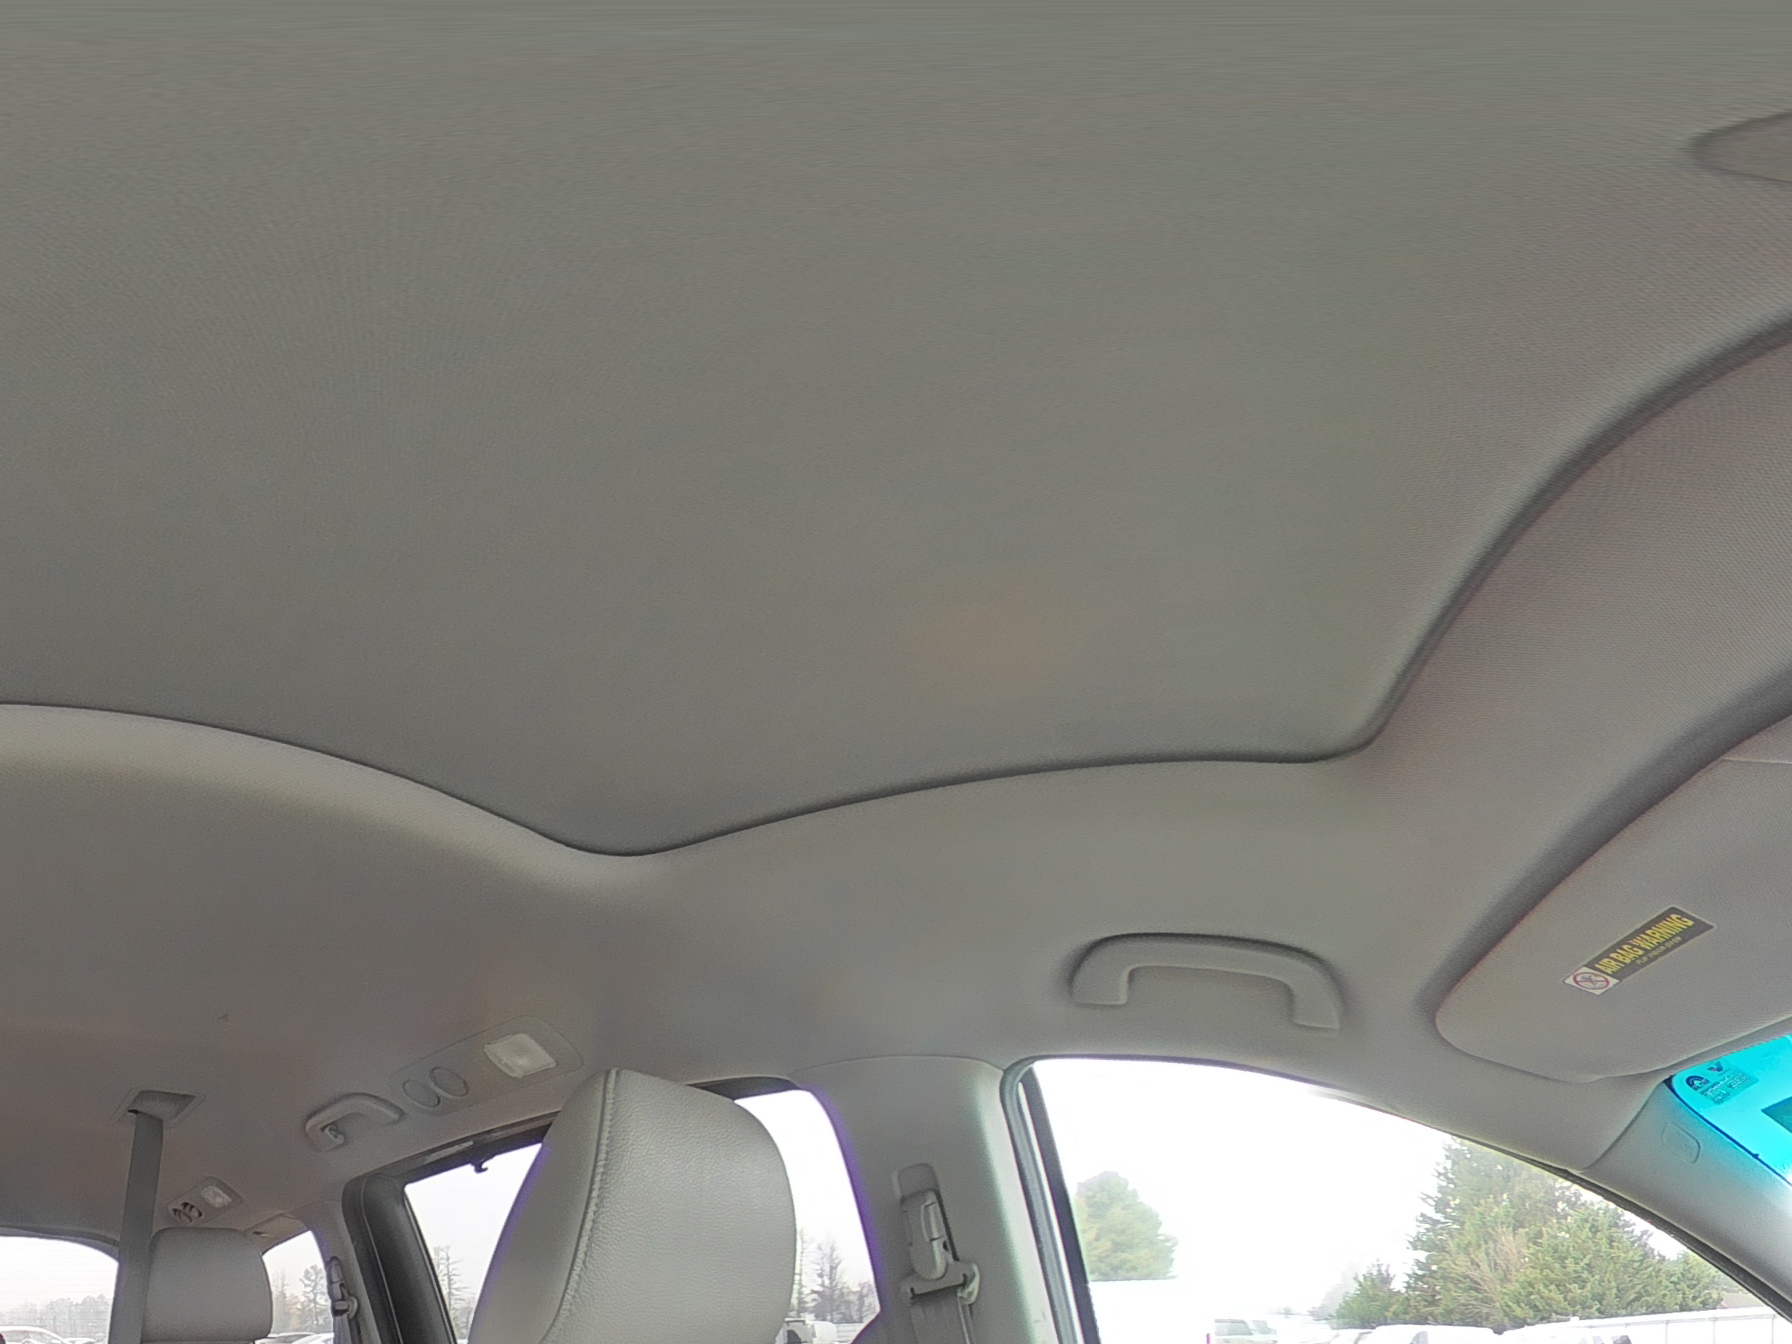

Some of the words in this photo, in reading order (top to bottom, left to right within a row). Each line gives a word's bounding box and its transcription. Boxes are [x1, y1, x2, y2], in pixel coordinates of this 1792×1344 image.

[1594, 957, 1625, 975] AIR
[1614, 943, 1645, 964] BAG
[1633, 913, 1695, 951] WARNING
